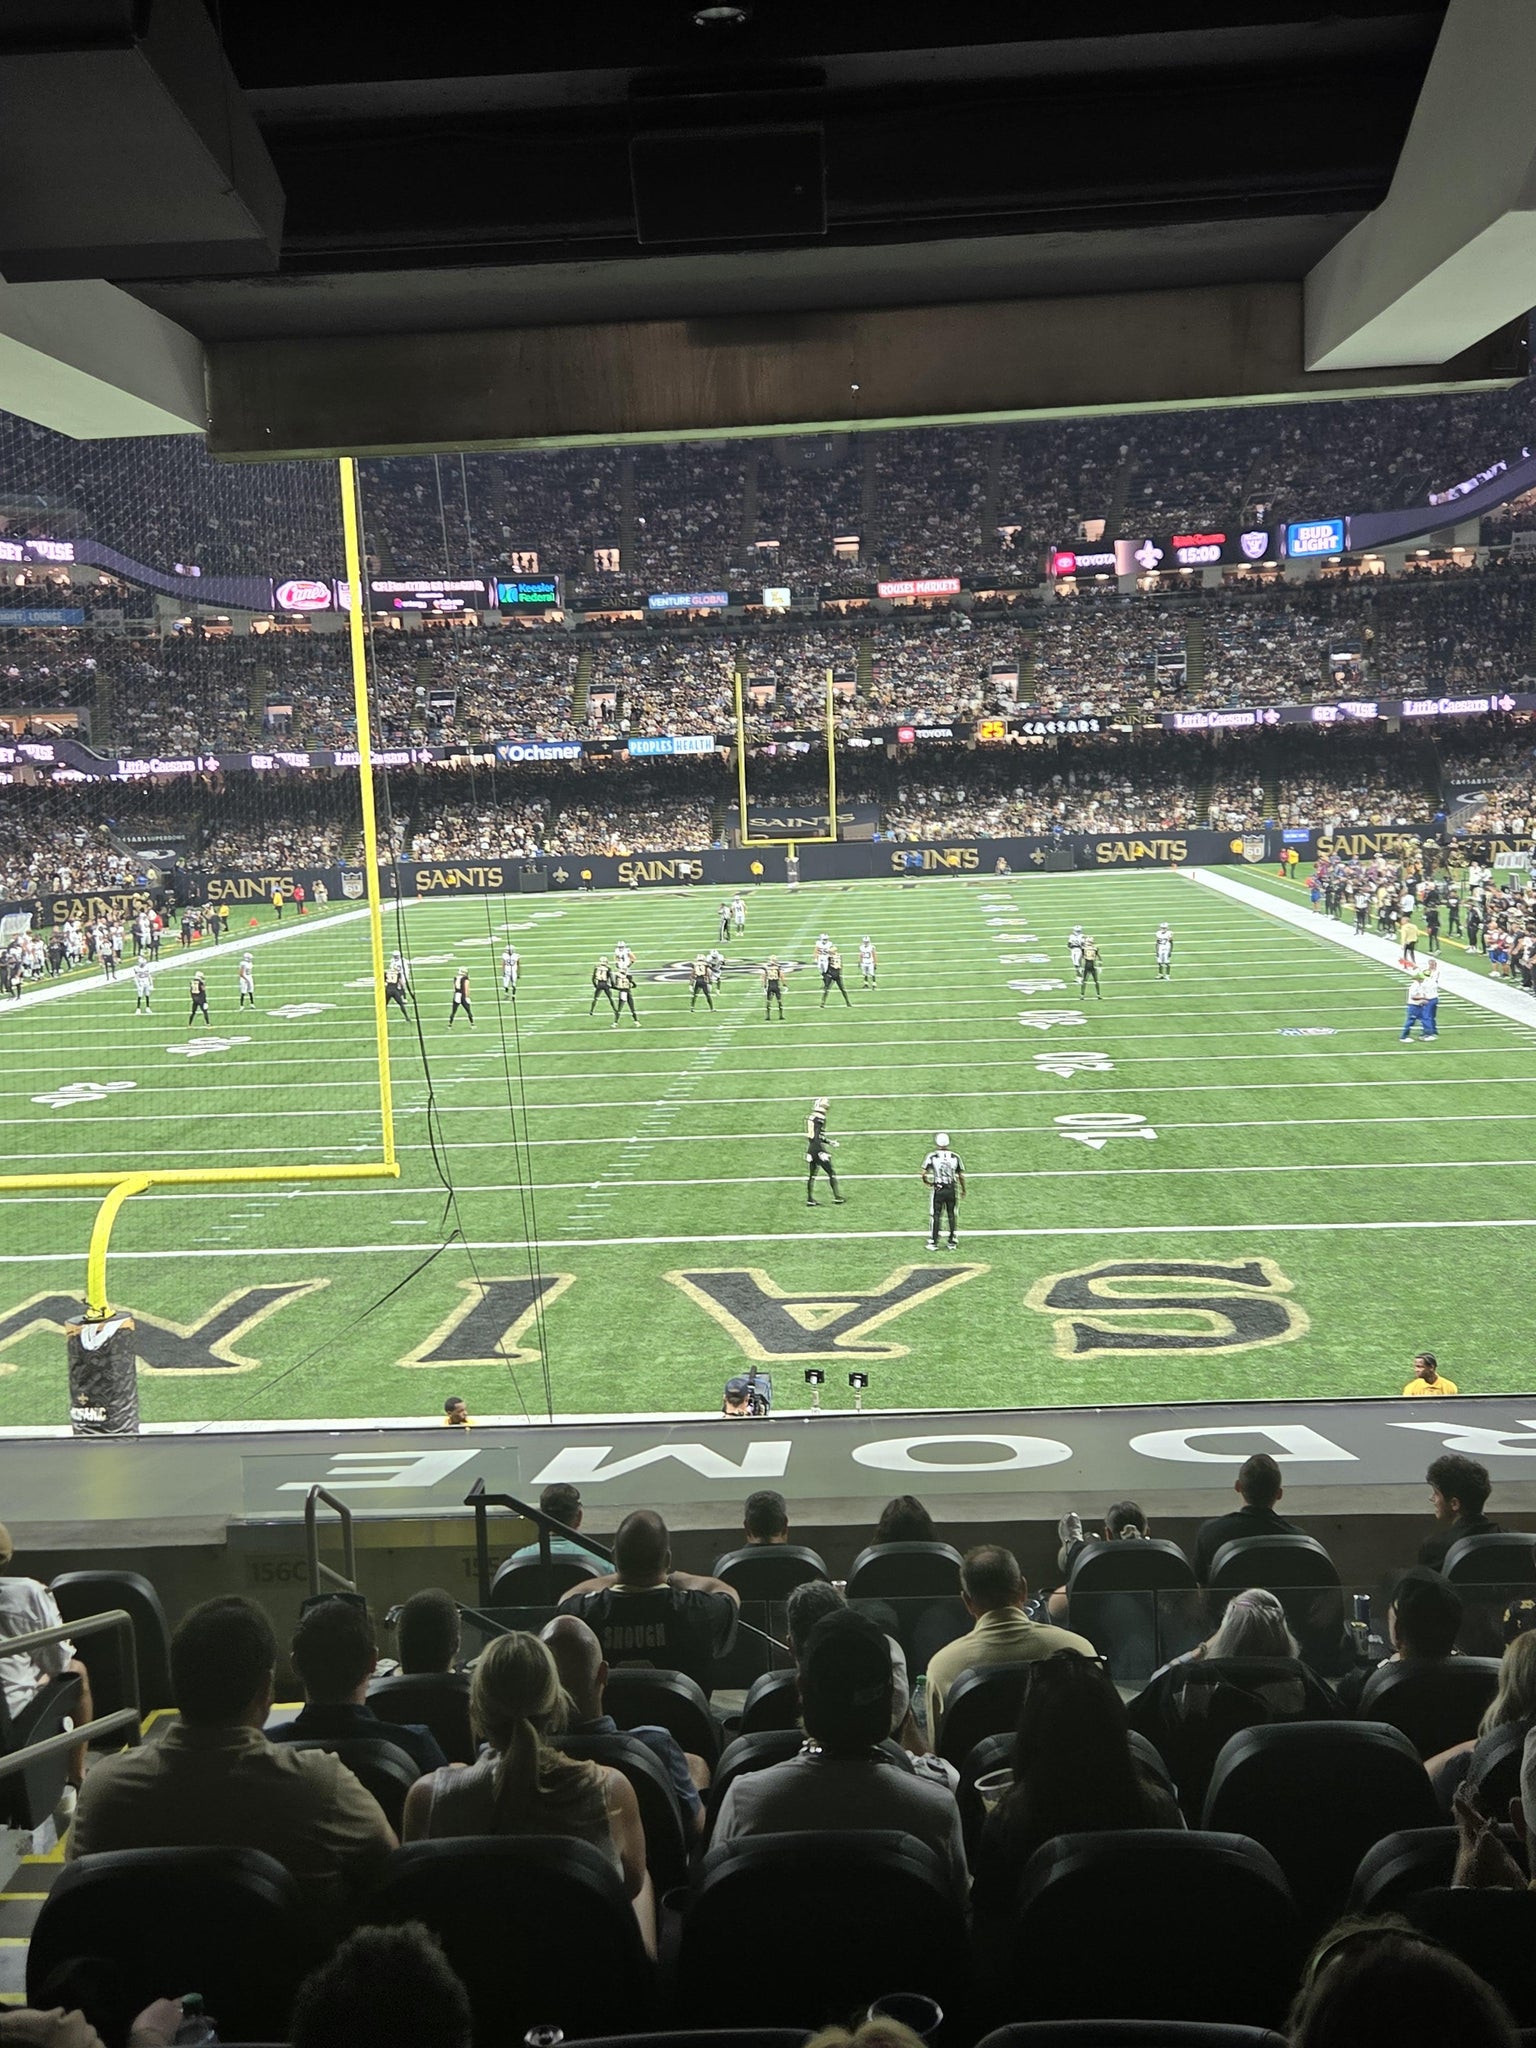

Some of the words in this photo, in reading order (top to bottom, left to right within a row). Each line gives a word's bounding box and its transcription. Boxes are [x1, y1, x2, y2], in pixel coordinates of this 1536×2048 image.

[1298, 525, 1333, 541] BUD
[1292, 535, 1339, 553] LIGHT
[1074, 553, 1117, 567] TOYOTA
[1177, 545, 1221, 563] 15:00
[519, 583, 555, 592] Keesler
[880, 582, 914, 595] ROUSES
[916, 579, 958, 593] MARKETS
[519, 593, 555, 602] Federal
[601, 597, 639, 608] SAINTS
[650, 597, 691, 607] VENTURE
[692, 595, 727, 605] GLOBAL
[1402, 700, 1438, 715] Little
[1438, 698, 1489, 713] Caesars
[1022, 719, 1100, 734] CAESARS
[1113, 714, 1157, 725] SAINTS
[1174, 713, 1208, 728] Little
[1208, 712, 1255, 726] Caesars
[914, 729, 953, 739] TOYOTA
[981, 721, 1005, 738] 25
[508, 745, 581, 761] Ochsner
[631, 740, 672, 753] PEOPLES
[674, 738, 712, 751] HEALTH
[118, 760, 150, 774] Little
[150, 758, 195, 772] Caesars
[749, 813, 856, 828] SAINTS
[1096, 840, 1187, 863] SAINTS
[1317, 833, 1415, 857] SAINT
[618, 859, 703, 883] SAINTS
[207, 877, 294, 900] SAINTS
[1033, 1052, 1117, 1079] 20
[1053, 1113, 1158, 1150] 10
